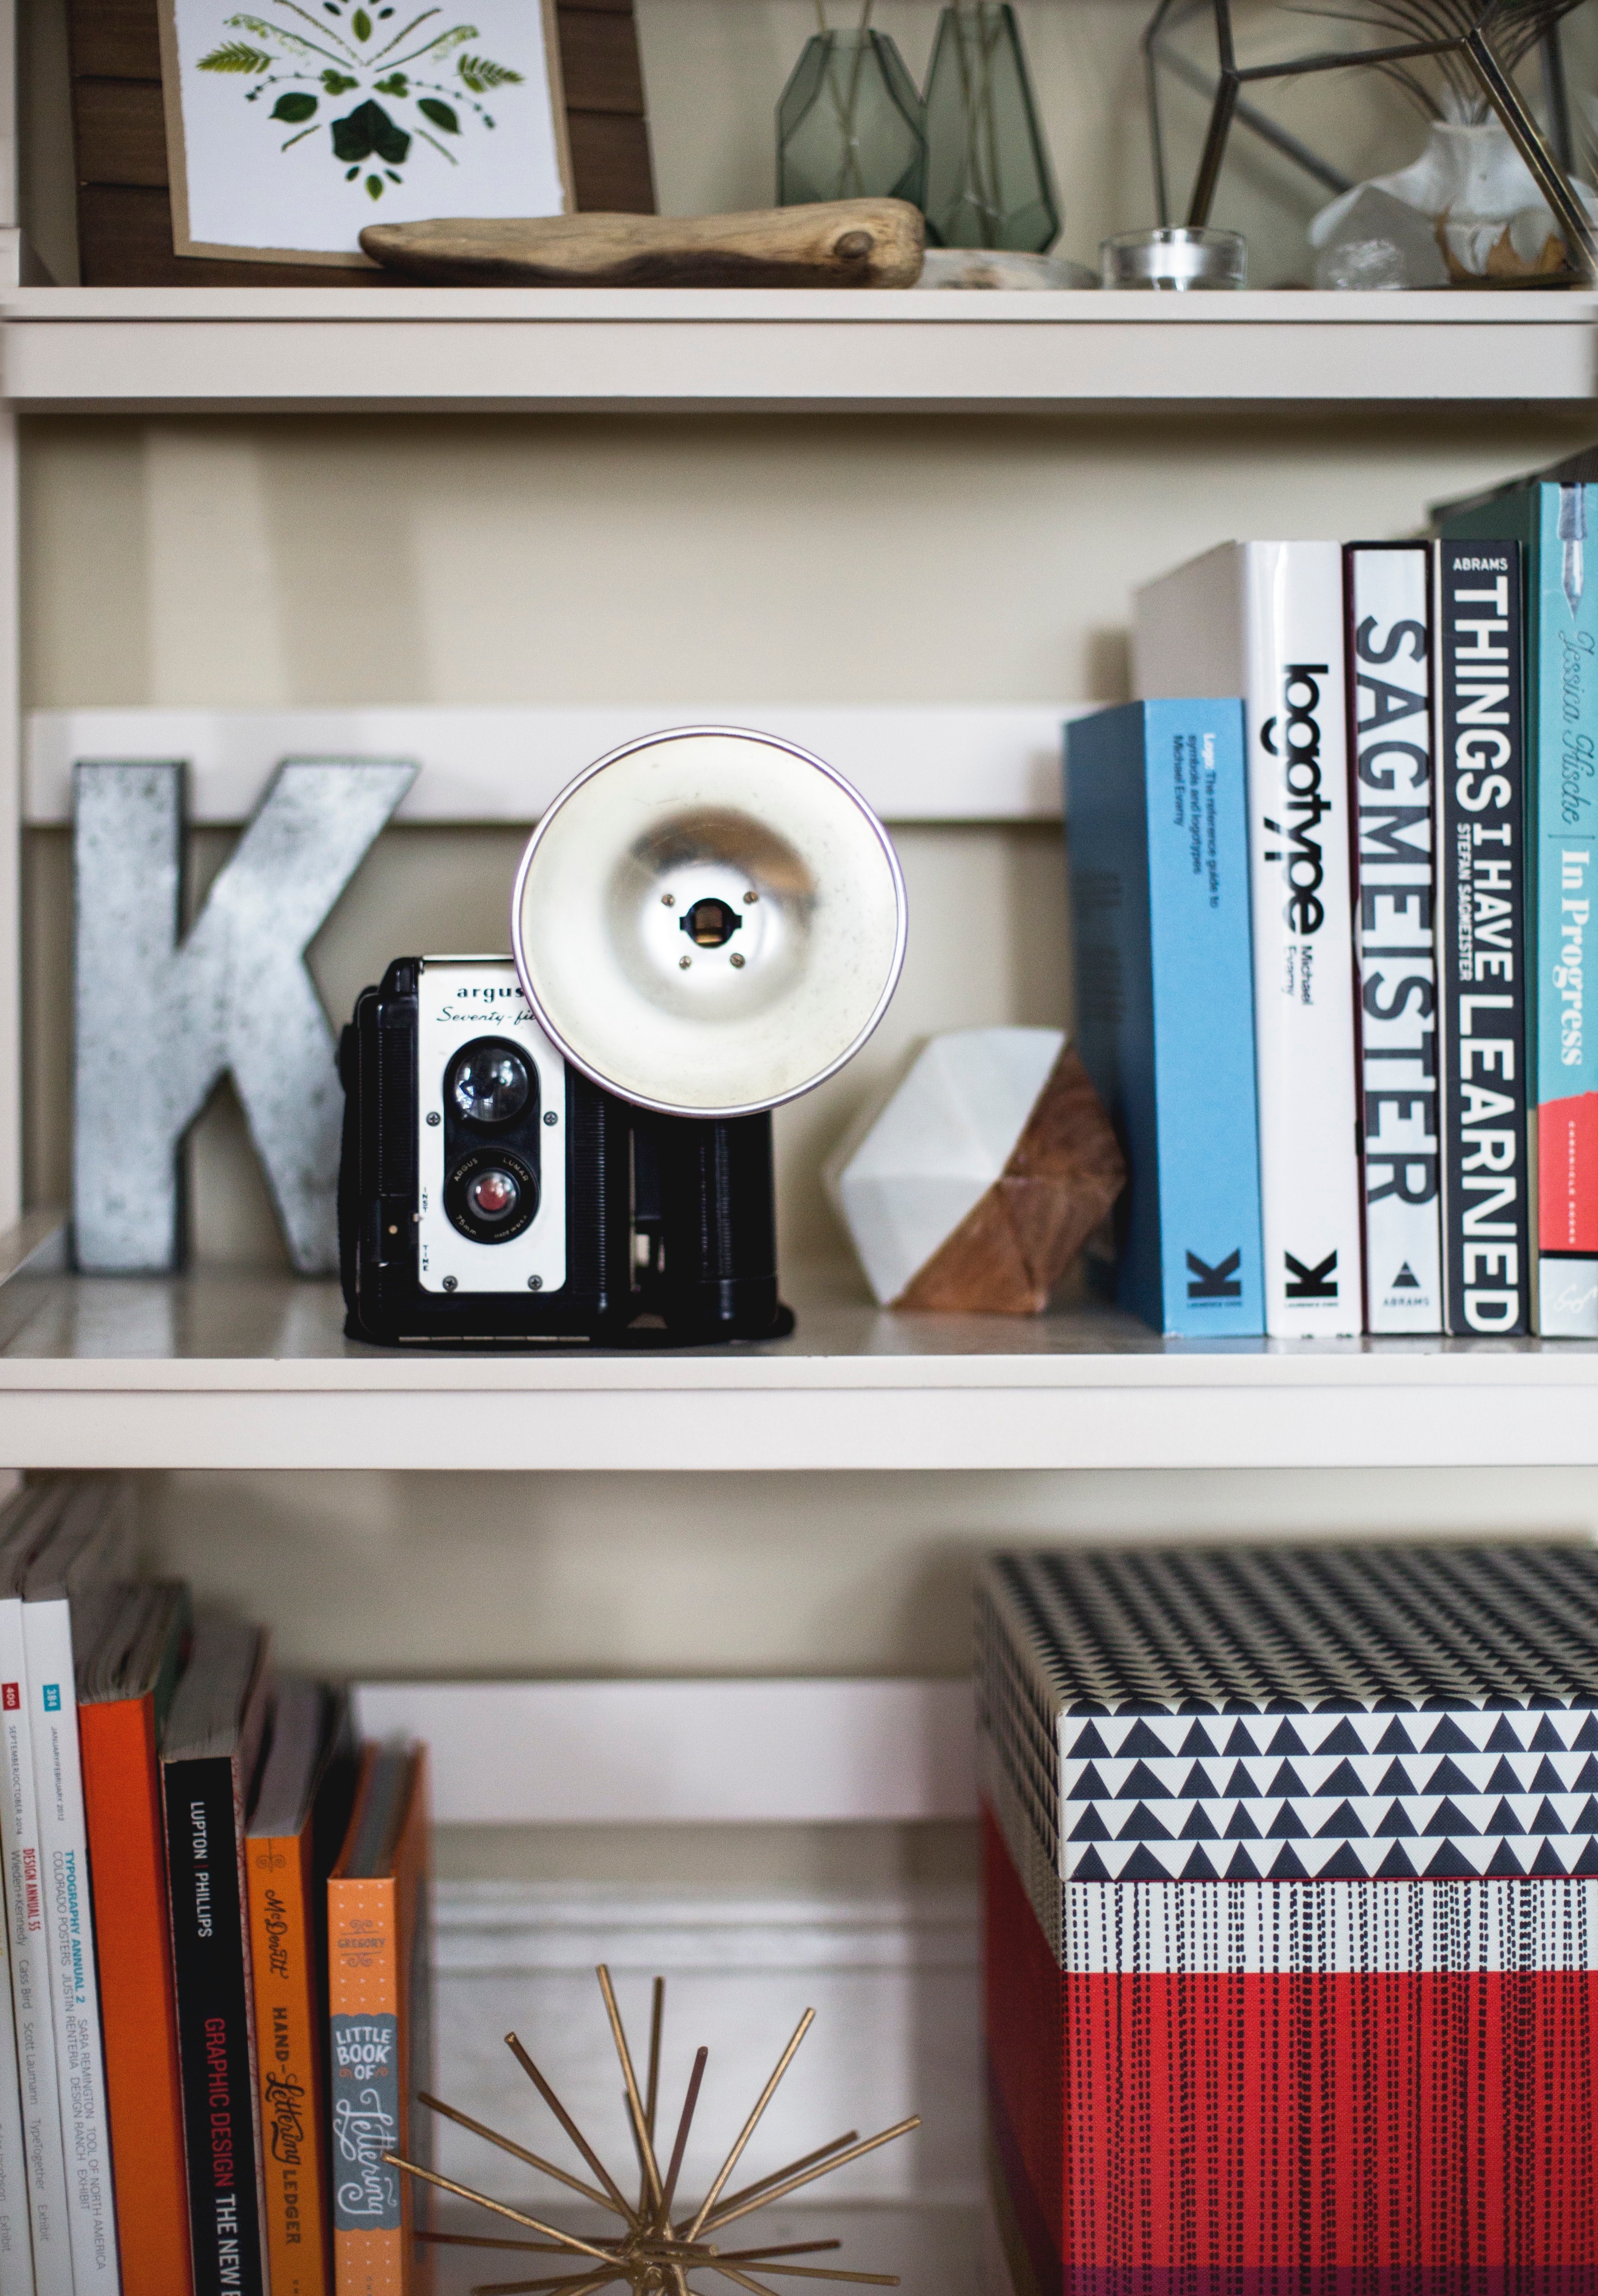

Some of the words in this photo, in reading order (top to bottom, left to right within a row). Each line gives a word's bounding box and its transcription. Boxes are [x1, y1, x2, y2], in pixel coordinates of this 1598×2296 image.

[1453, 558, 1508, 571] ABRAMS
[1454, 576, 1512, 812] THINGS
[1558, 629, 1595, 723] Jessica
[1260, 664, 1332, 935] logotype
[1457, 822, 1472, 880] STEFAN
[1473, 822, 1512, 846] I
[1561, 848, 1590, 890] In
[1355, 615, 1439, 1205] SAGMEISTER
[1458, 884, 1473, 982] SAGMEISTER
[1473, 859, 1513, 982] HAVE
[456, 987, 526, 1003] argus
[1283, 945, 1297, 997] Evamy
[1301, 945, 1314, 1006] Michael
[1552, 896, 1590, 1066] Progress
[71, 760, 421, 1277] K
[454, 1158, 478, 1182] ARGUS
[503, 1157, 529, 1182] LUMAR
[1459, 994, 1520, 1332] LEARNED
[1284, 1248, 1339, 1298] K
[1382, 1297, 1430, 1307] ABRAMS
[6, 1686, 17, 1706] 400
[46, 1688, 57, 1707] 384
[190, 1801, 208, 1860] LUPTON
[23, 1848, 37, 1881] DESIGN
[52, 1850, 67, 1914] COLORADO
[11, 1850, 27, 1946] Wieden+Kennedy
[26, 1883, 39, 1919] ANNUAL
[65, 1849, 80, 1935] TYPOGRAPHY
[195, 1871, 213, 1938] PHILLIPS
[59, 1916, 70, 1967] POSTERS
[264, 1889, 289, 1980] McDevitt
[336, 1938, 387, 1949] GREGORY
[19, 1959, 28, 1985] Cass
[72, 1938, 85, 1992] ANNUAL
[21, 1988, 32, 2009] Bird
[62, 1974, 74, 2012] JUSTIN
[75, 1995, 85, 2004] 2
[24, 2022, 35, 2051] Scott
[66, 2015, 79, 2070] RENTERIA
[77, 2019, 89, 2050] SARA
[335, 2026, 392, 2045] LITTLE
[336, 2043, 392, 2066] BOOK
[26, 2053, 38, 2105] Laumann
[80, 2052, 95, 2119] REMINGTON
[204, 2017, 230, 2108] GRAPHIC
[353, 2064, 376, 2080] OF
[70, 2077, 83, 2119] DESIGN
[30, 2119, 44, 2190] TypeTogether
[74, 2121, 86, 2161] RANCH
[86, 2125, 97, 2156] TOOL
[210, 2112, 235, 2187] DESIGN
[333, 2088, 397, 2215] Lettering
[77, 2169, 90, 2210] EXHIBIT
[88, 2159, 99, 2174] OF
[89, 2178, 102, 2216] NORTH
[215, 2193, 239, 2235] THE
[282, 2169, 302, 2246] LEDGER
[38, 2204, 49, 2241] Exhibit
[94, 2219, 106, 2270] AMERICA
[217, 2238, 241, 2285] NEW
